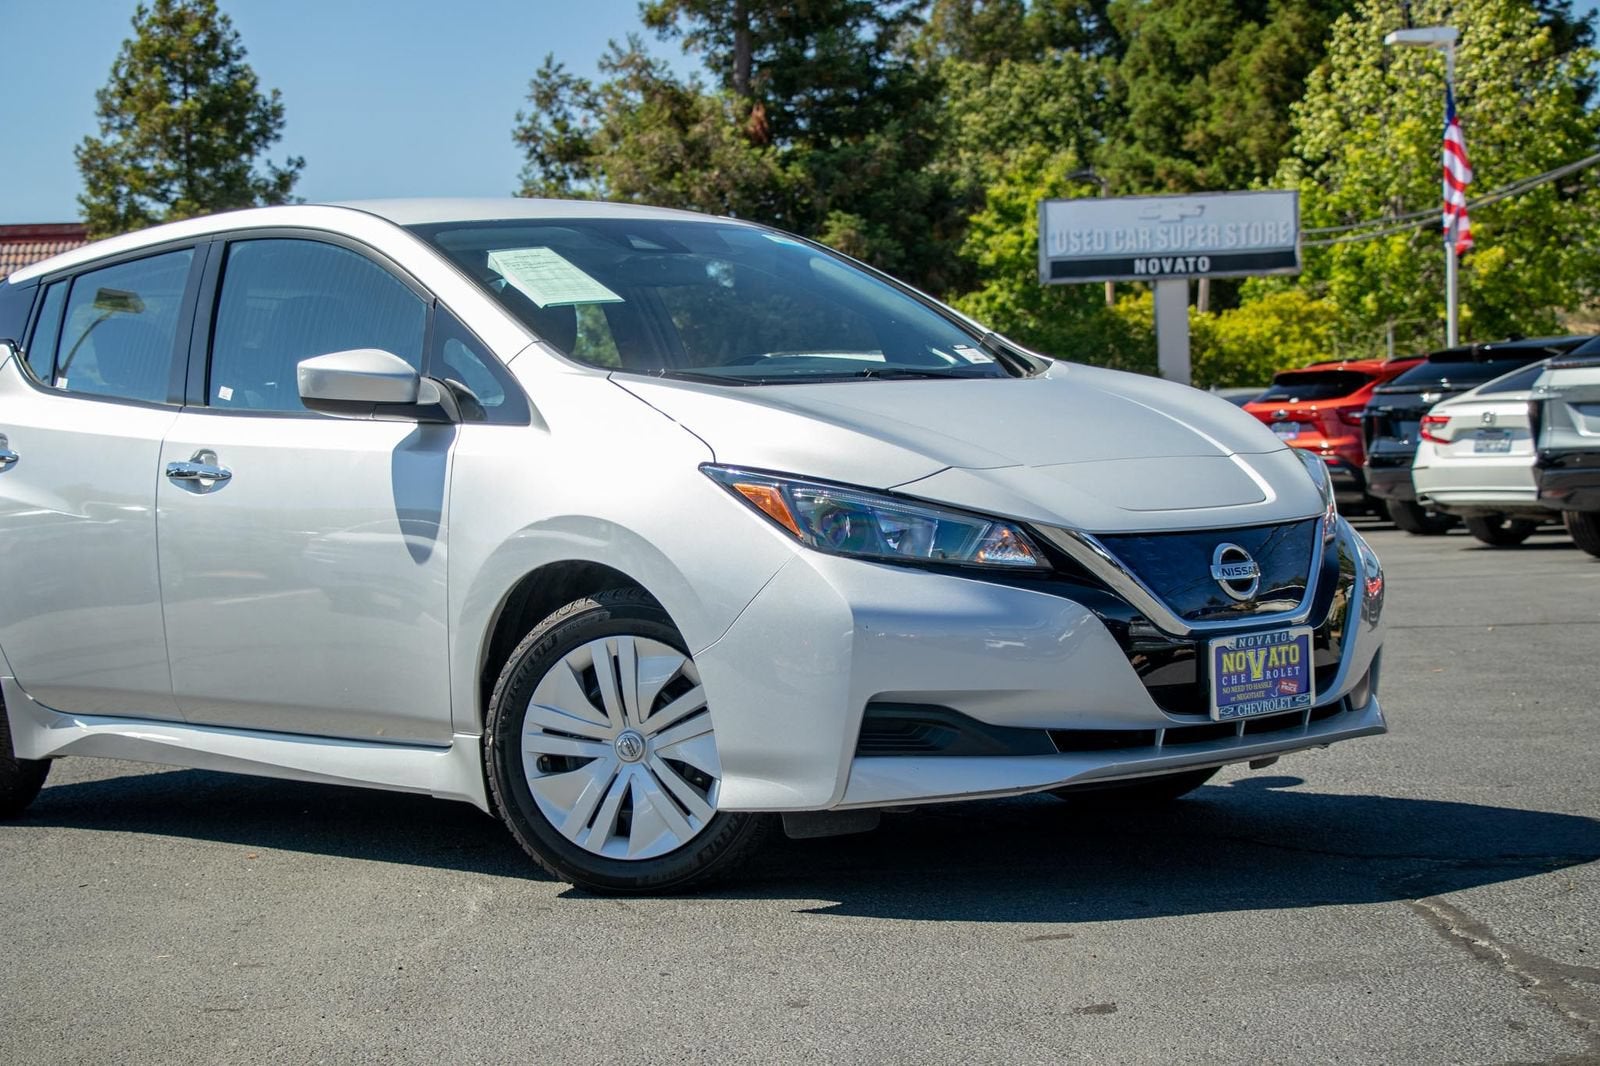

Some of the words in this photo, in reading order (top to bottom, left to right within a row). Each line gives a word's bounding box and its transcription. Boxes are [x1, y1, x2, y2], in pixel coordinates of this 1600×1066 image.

[1055, 228, 1106, 252] USED
[1112, 227, 1151, 251] CAR
[1156, 224, 1219, 250] SUPER
[1225, 221, 1289, 247] STORE
[1133, 256, 1210, 275] NOVATO
[1238, 632, 1287, 648] NOVATO
[1222, 644, 1300, 681] NOVATO
[1222, 686, 1231, 694] NO
[1238, 696, 1292, 716] CHEVROLET
